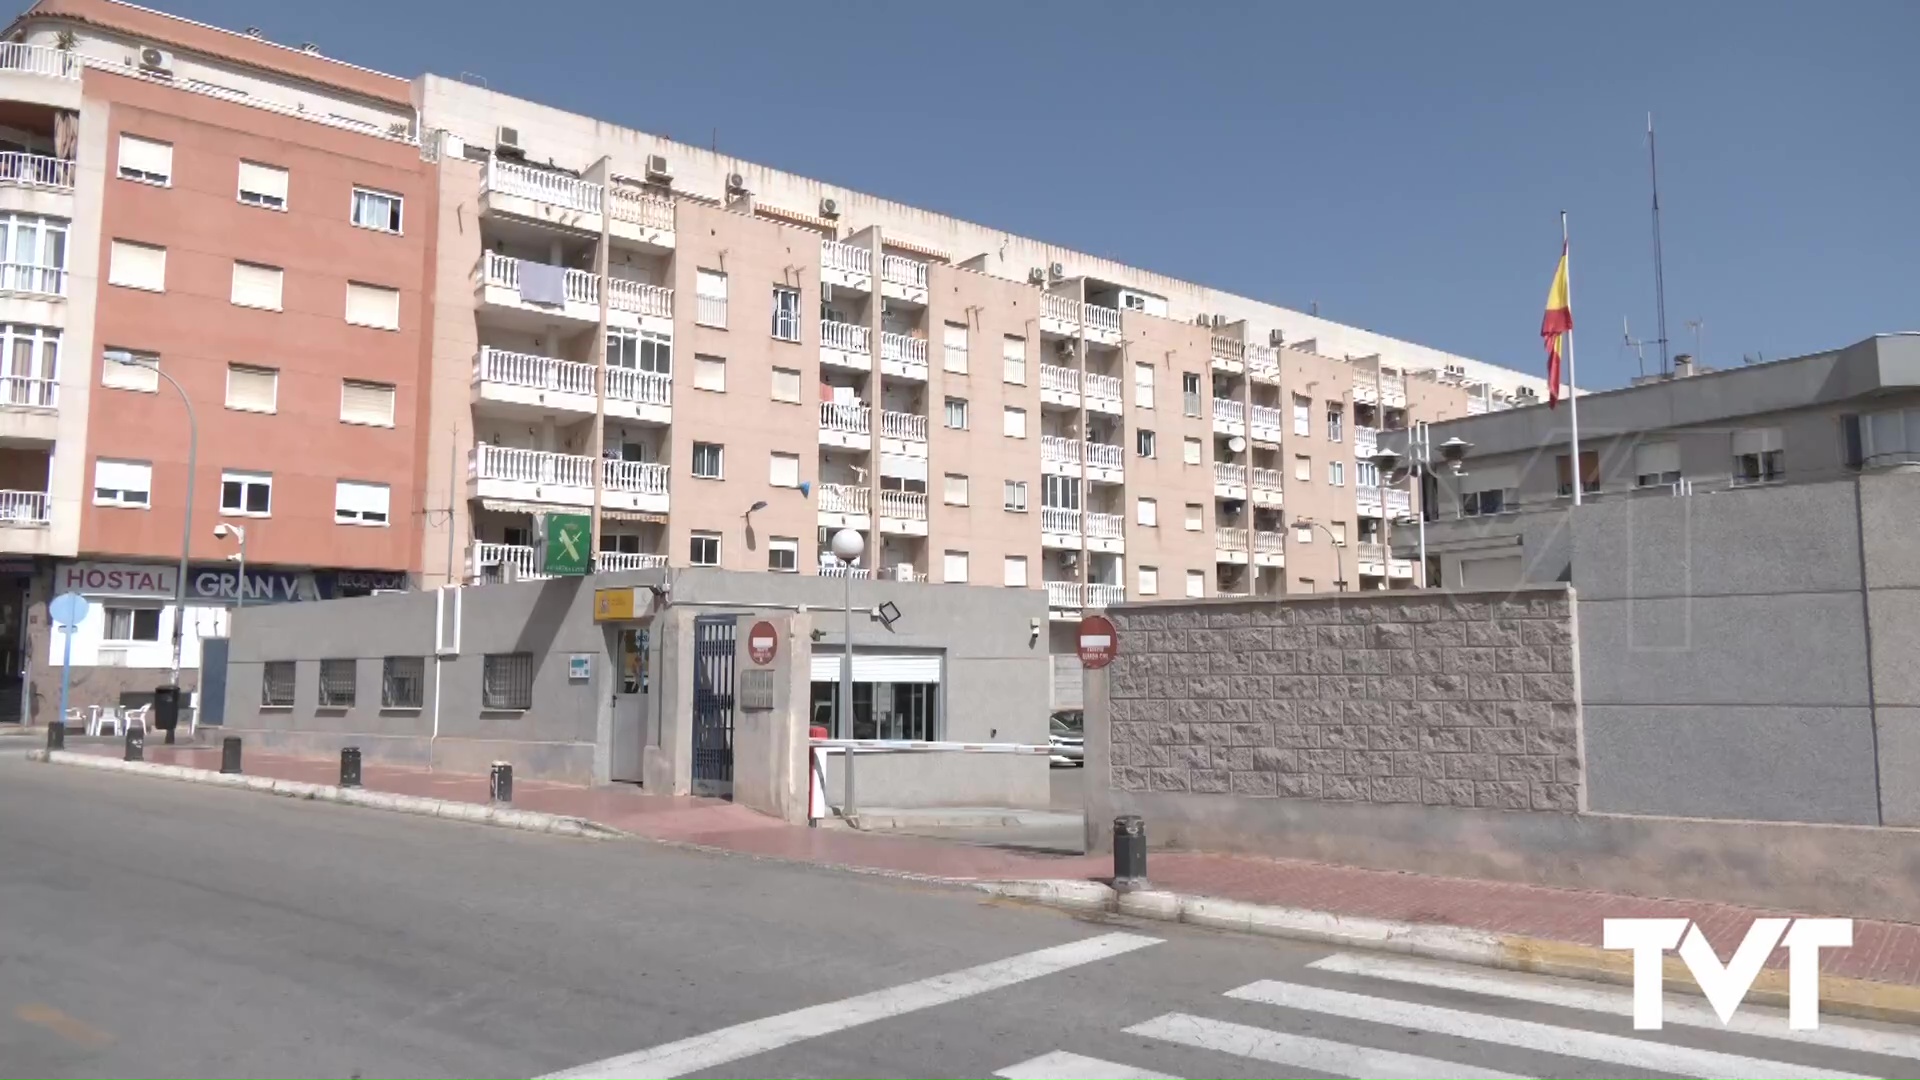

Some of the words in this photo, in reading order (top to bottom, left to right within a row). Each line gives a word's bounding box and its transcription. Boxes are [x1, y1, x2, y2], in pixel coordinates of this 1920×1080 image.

[67, 569, 170, 592] HOSTAL
[195, 572, 274, 599] GRAN
[280, 576, 322, 601] VA
